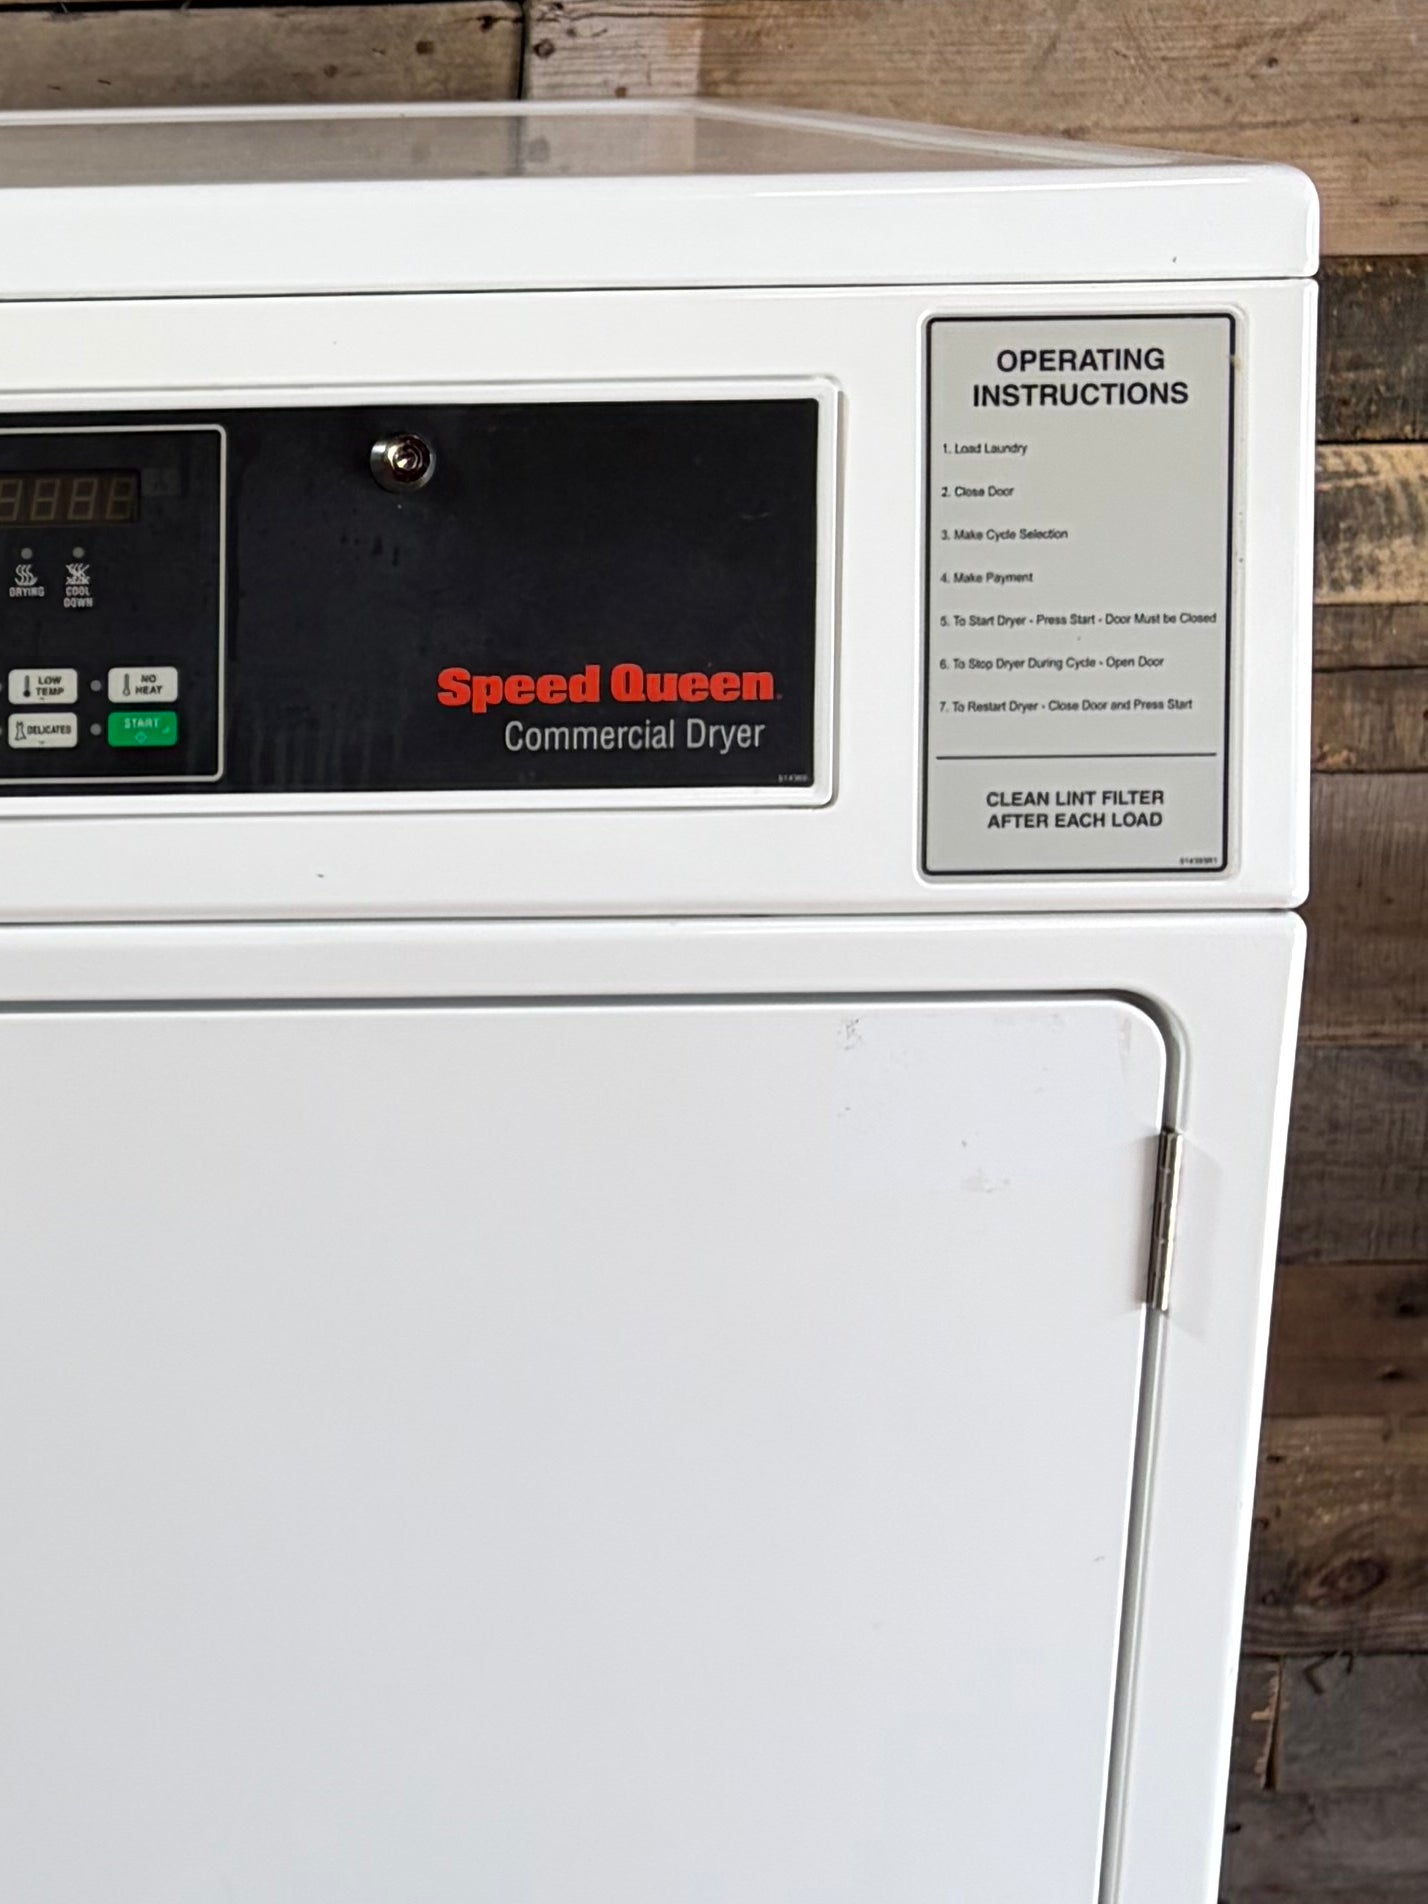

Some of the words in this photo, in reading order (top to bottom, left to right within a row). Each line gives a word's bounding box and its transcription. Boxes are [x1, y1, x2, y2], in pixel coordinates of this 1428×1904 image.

[996, 347, 1165, 373] OPERATING
[972, 381, 1189, 408] INSTRUCTIONS
[954, 443, 982, 455] Load
[984, 442, 1028, 457] Laundry
[954, 485, 985, 498] Close
[987, 485, 1015, 498] Door
[953, 529, 984, 541] Make
[986, 528, 1017, 543] Cycle
[1019, 528, 1069, 540] Selection
[953, 572, 983, 584] Make
[985, 571, 1034, 586] Payment
[8, 586, 45, 597] DRYING
[65, 586, 90, 597] COOL
[952, 614, 966, 627] To
[968, 614, 994, 627] Start
[997, 613, 1027, 629] Dryer
[1036, 613, 1067, 626] Press
[1069, 613, 1095, 625] Start
[1105, 613, 1131, 625] Door
[1134, 612, 1160, 625] Must
[1162, 612, 1177, 624] be
[1179, 612, 1217, 624] Closed
[952, 657, 966, 670] To
[968, 657, 994, 672] Stop
[995, 657, 1025, 672] Dryer
[1027, 657, 1063, 671] During
[1065, 656, 1096, 671] Cycle
[1105, 656, 1136, 670] Open
[1138, 655, 1164, 668] Door
[37, 676, 62, 686] LOW
[140, 674, 157, 684] NO
[35, 686, 65, 697] TEMP
[134, 685, 163, 695] HEAT
[437, 664, 601, 714] Speed
[610, 663, 774, 704] Queen
[952, 700, 965, 713] To
[967, 700, 1006, 713] Restart
[1009, 700, 1039, 714] Dryer
[1048, 699, 1079, 712] Close
[1081, 699, 1108, 711] Door
[1110, 698, 1131, 711] and
[1133, 698, 1164, 711] Press
[1166, 698, 1193, 710] Start
[26, 725, 72, 735] DELICATES
[124, 717, 160, 729] START
[504, 719, 675, 752] Commercial
[686, 718, 766, 755] Dryer
[986, 791, 1050, 808] CLEAN
[1055, 790, 1097, 807] LINT
[1102, 789, 1165, 806] FILTER
[987, 813, 1049, 830] AFTER
[1054, 812, 1106, 829] EACH
[1111, 811, 1163, 828] LOAD
